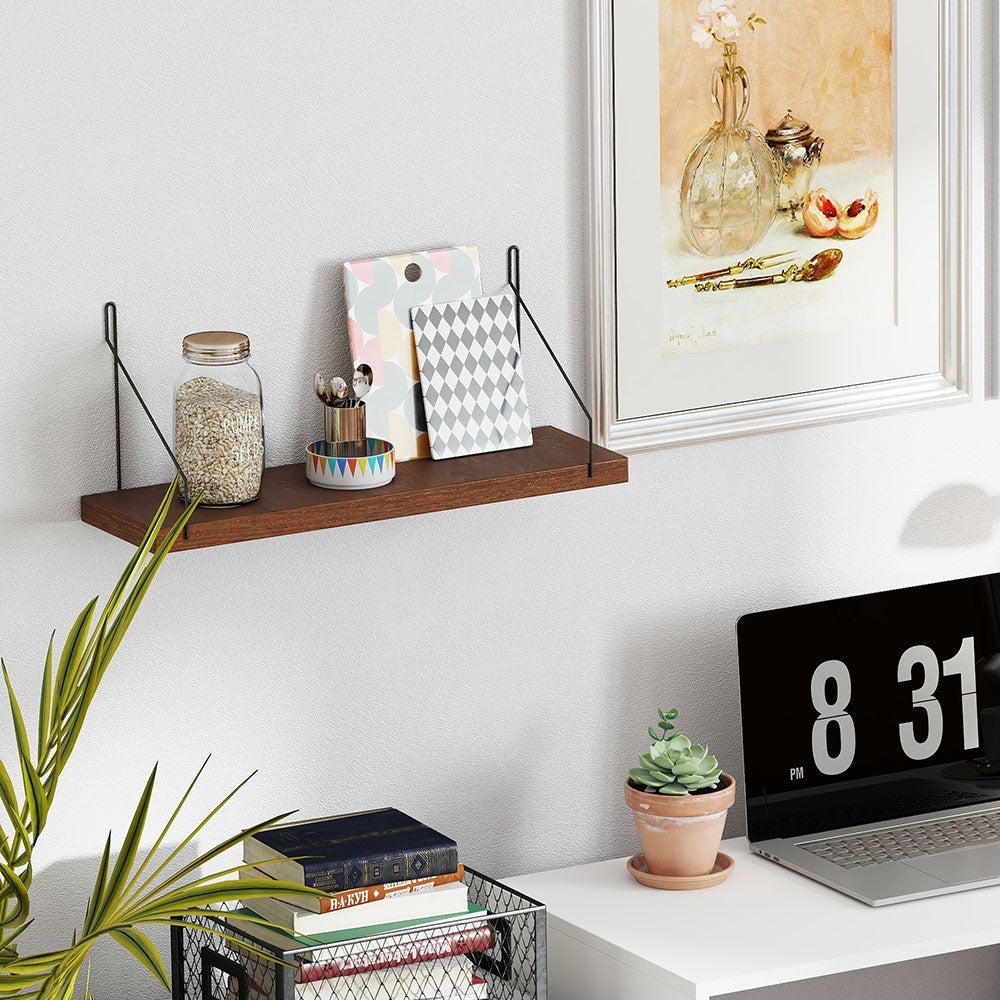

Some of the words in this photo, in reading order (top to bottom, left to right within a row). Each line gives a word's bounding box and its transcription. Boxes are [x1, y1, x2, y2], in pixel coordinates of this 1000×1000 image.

[811, 659, 857, 776] 8
[897, 636, 980, 761] 31
[789, 766, 804, 780] PM
